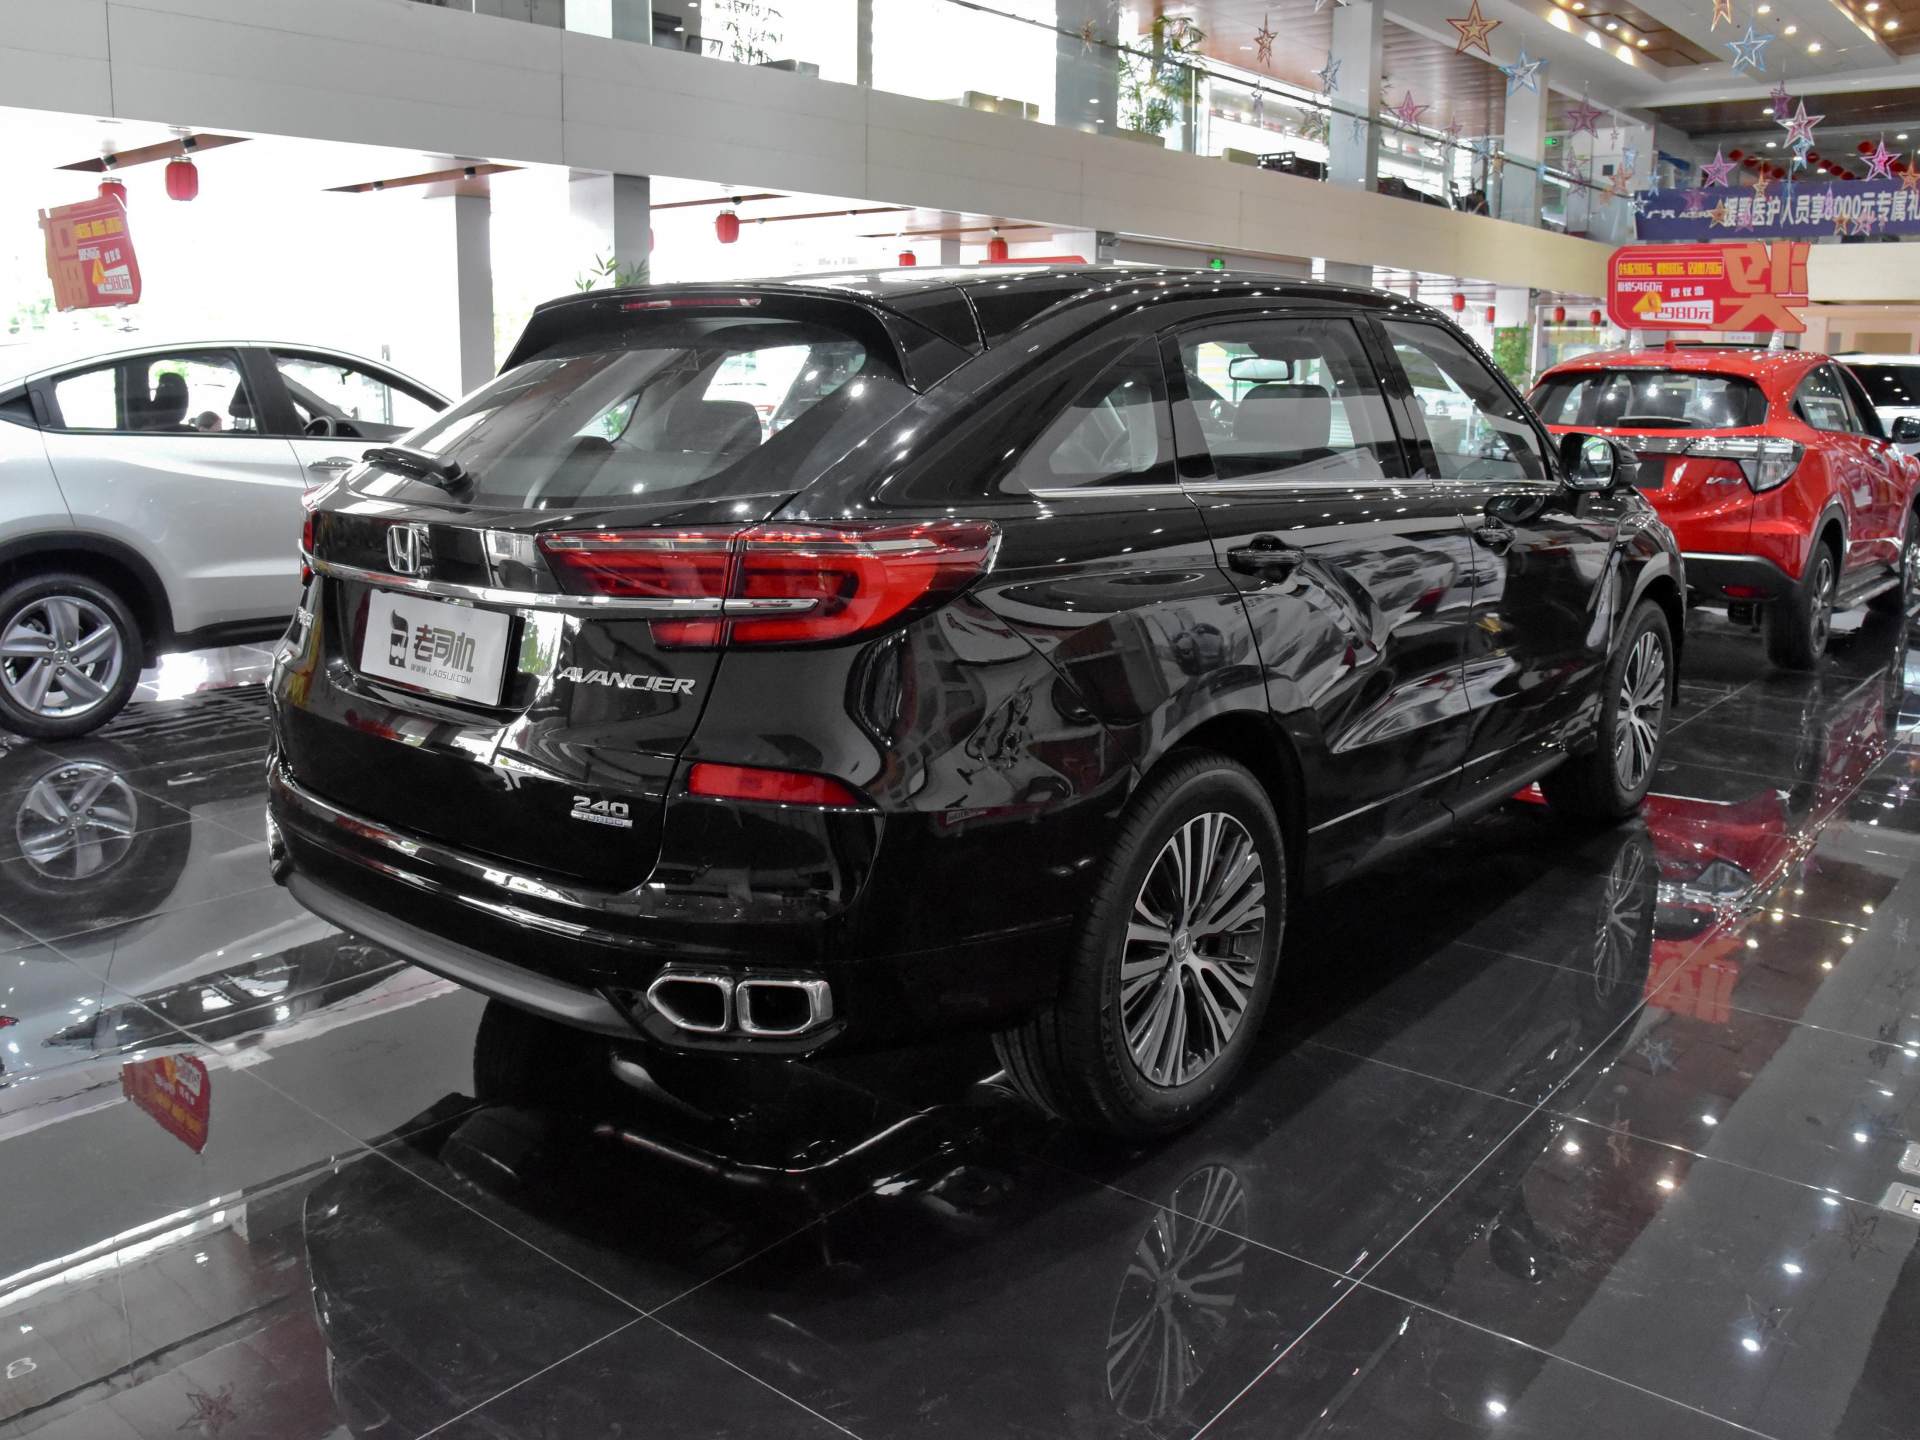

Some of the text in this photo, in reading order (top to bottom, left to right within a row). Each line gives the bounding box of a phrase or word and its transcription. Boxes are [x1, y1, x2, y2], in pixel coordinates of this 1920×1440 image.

[414, 624, 476, 673] 老司机
[556, 666, 696, 695] AVANCIER
[573, 795, 629, 818] 240
